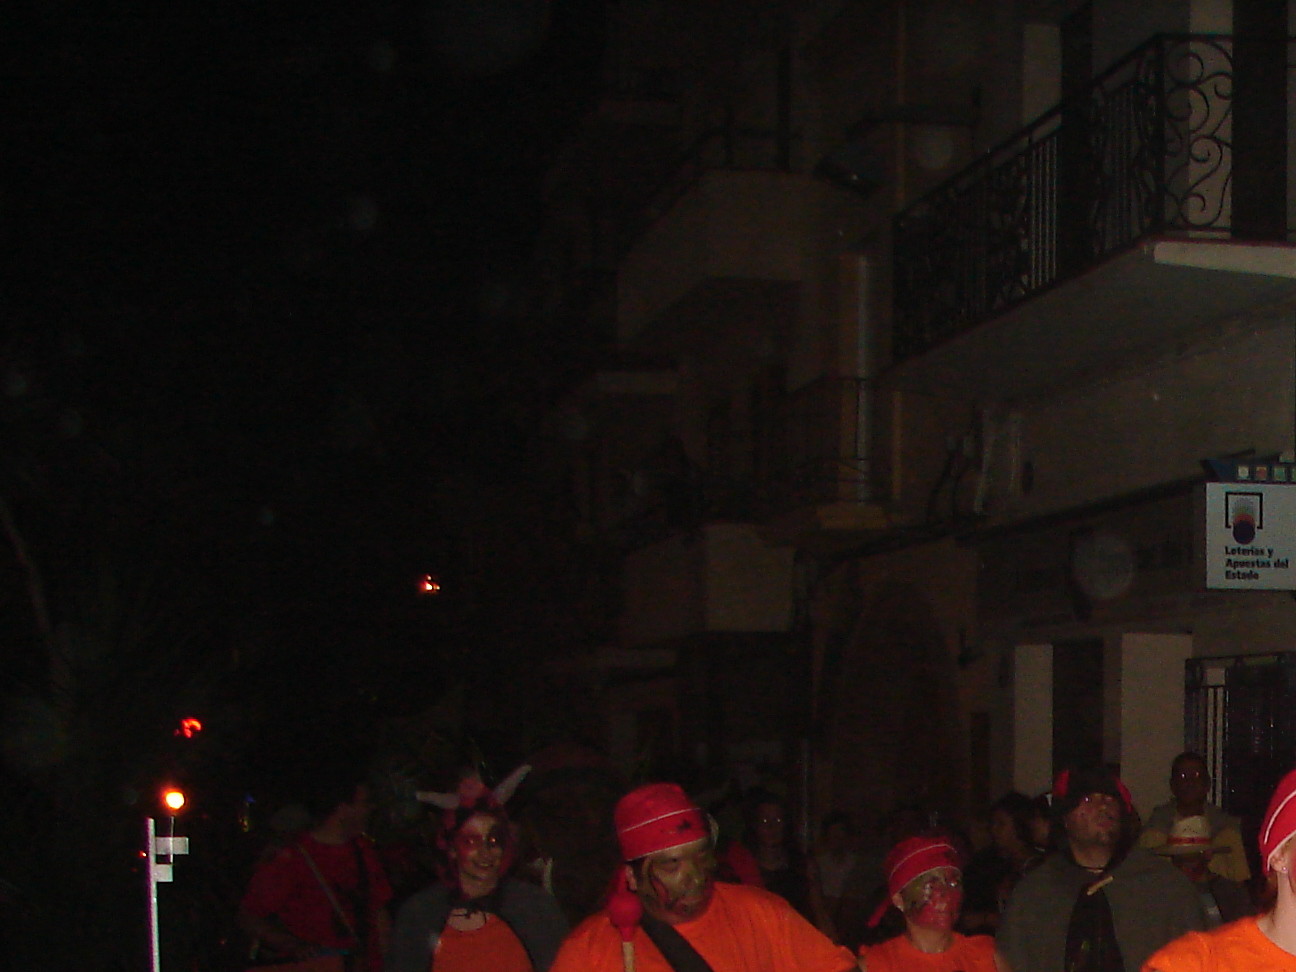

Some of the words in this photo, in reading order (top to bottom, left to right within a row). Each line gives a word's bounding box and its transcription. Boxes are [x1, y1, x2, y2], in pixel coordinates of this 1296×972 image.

[1267, 548, 1274, 558] y
[1226, 558, 1270, 569] Apuestas
[1274, 558, 1289, 568] del
[1225, 570, 1259, 580] Estado
